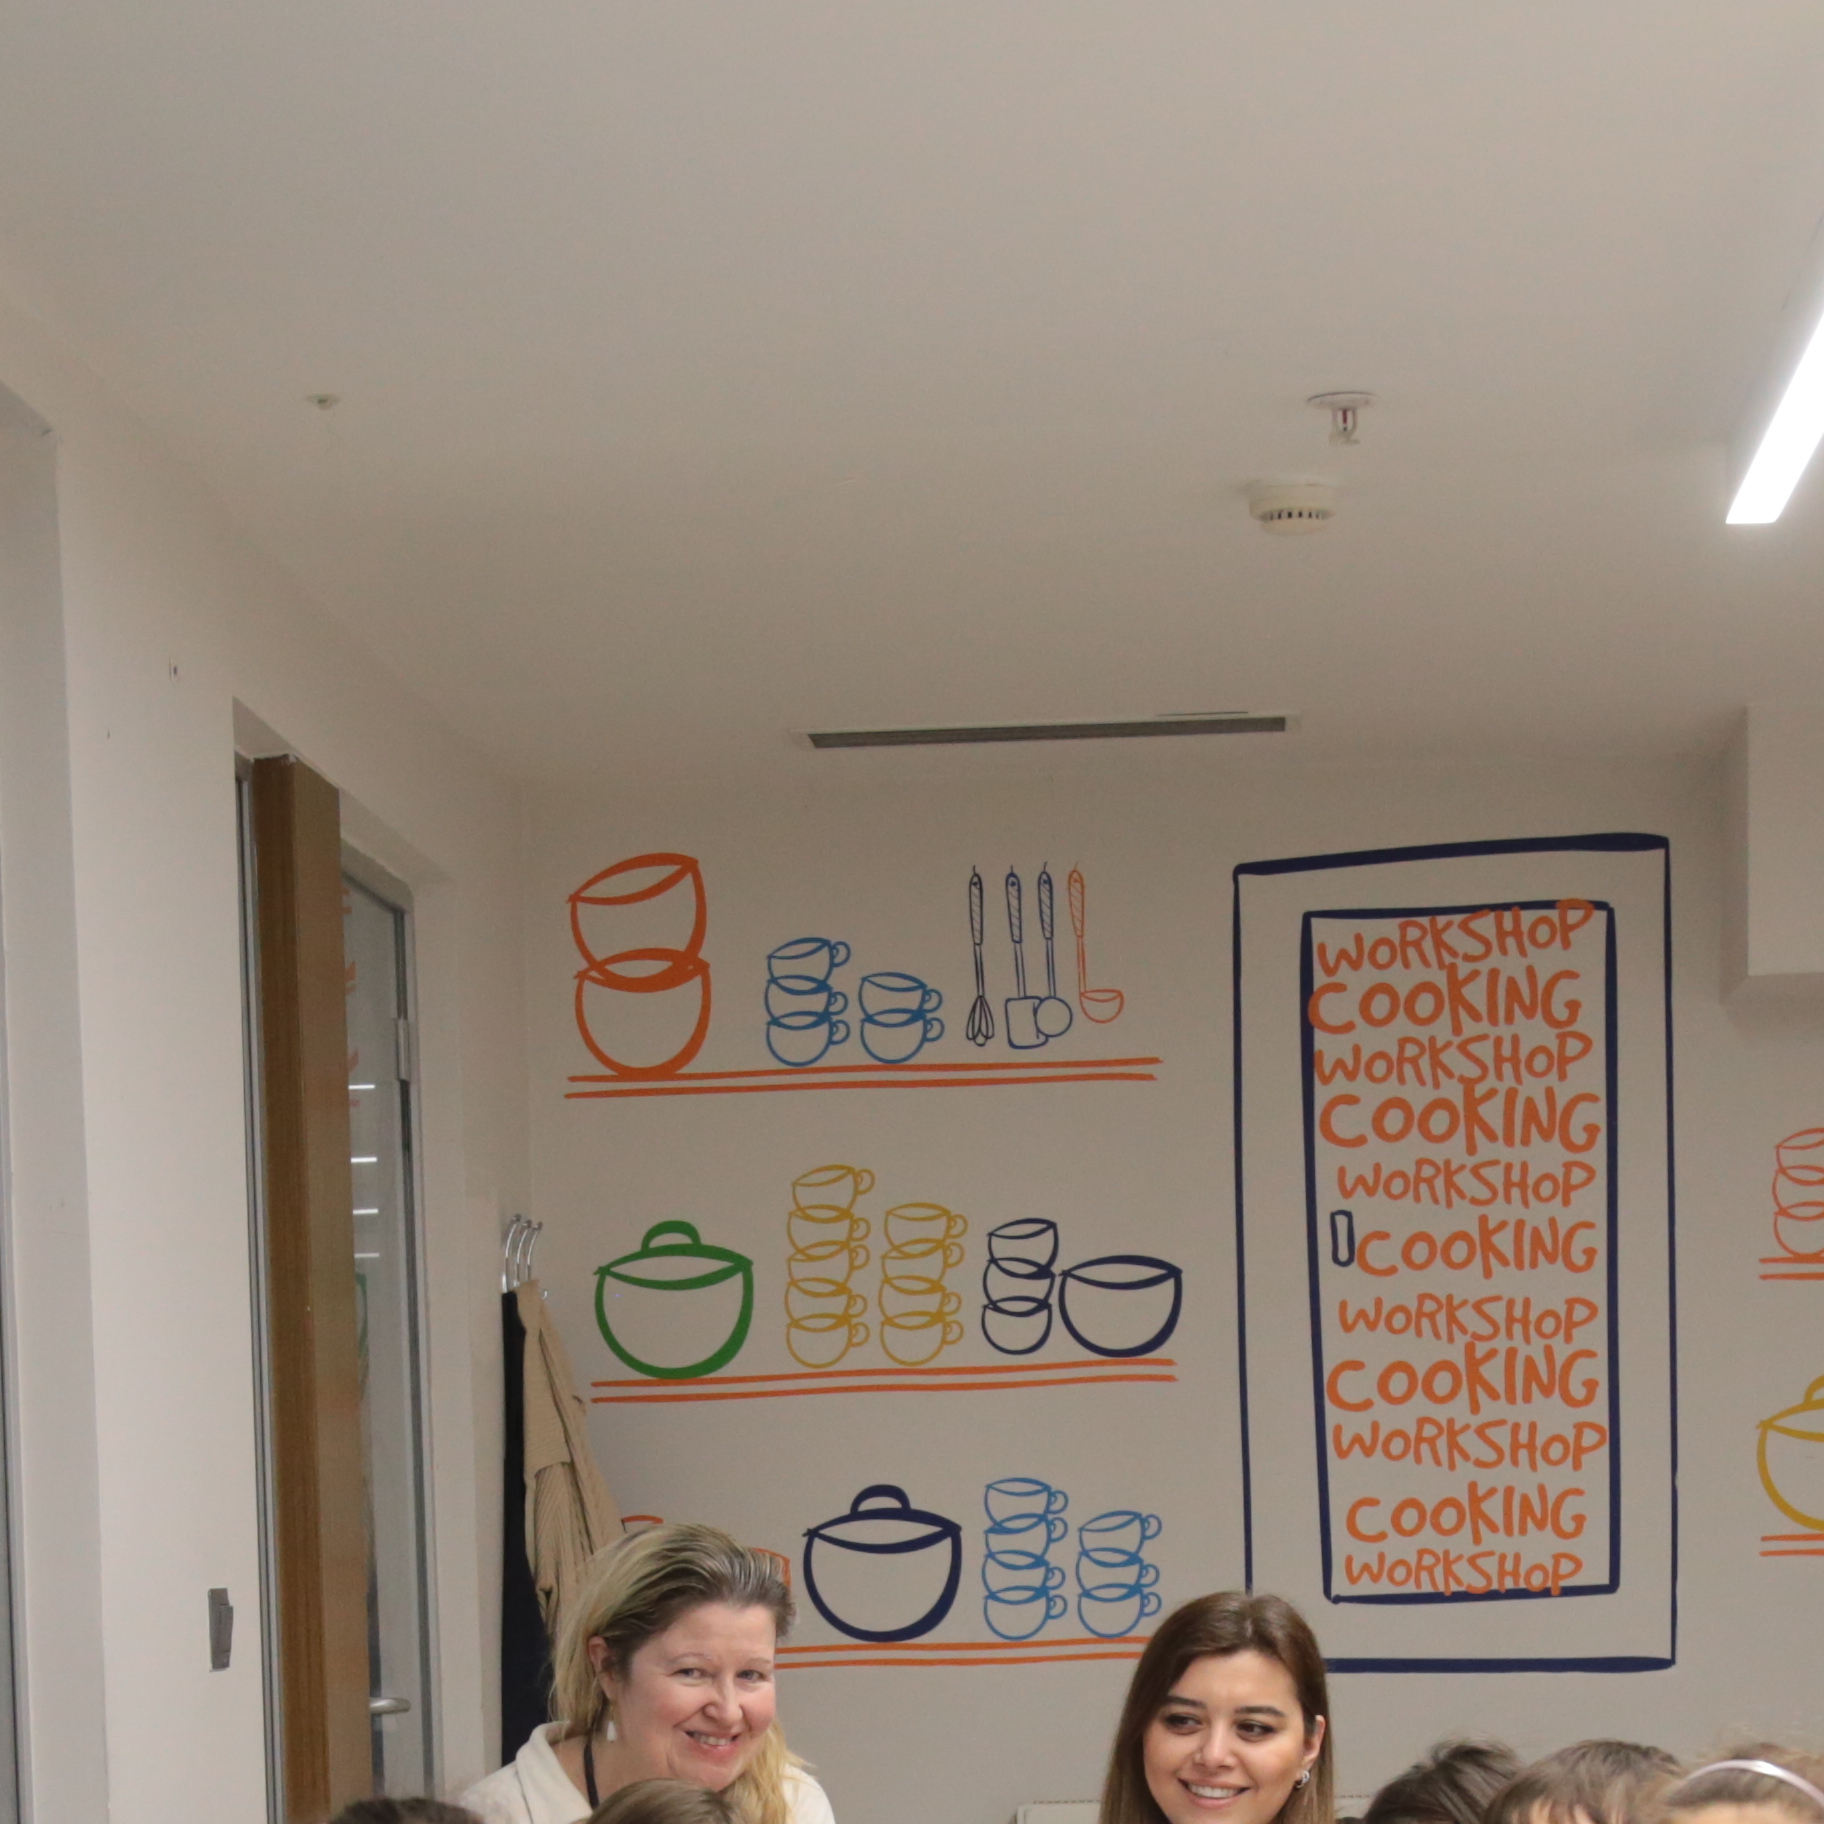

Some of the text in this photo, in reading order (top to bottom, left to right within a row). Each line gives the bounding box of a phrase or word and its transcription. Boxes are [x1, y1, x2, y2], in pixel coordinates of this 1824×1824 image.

[1317, 898, 1595, 976] WORKSHOP
[1307, 962, 1582, 1036] COOKING
[1314, 1031, 1593, 1088] WORKSHOP
[1319, 1080, 1601, 1155] COOKING
[1337, 1157, 1597, 1209] WORKSHOP
[1356, 1214, 1598, 1279] COOKING
[1338, 1292, 1599, 1345] WORKSHOP
[1326, 1341, 1599, 1415] COOKING
[1332, 1416, 1608, 1472] WORKSHOP
[1346, 1480, 1587, 1546] COOKING
[1344, 1548, 1583, 1596] WORKSHOP
